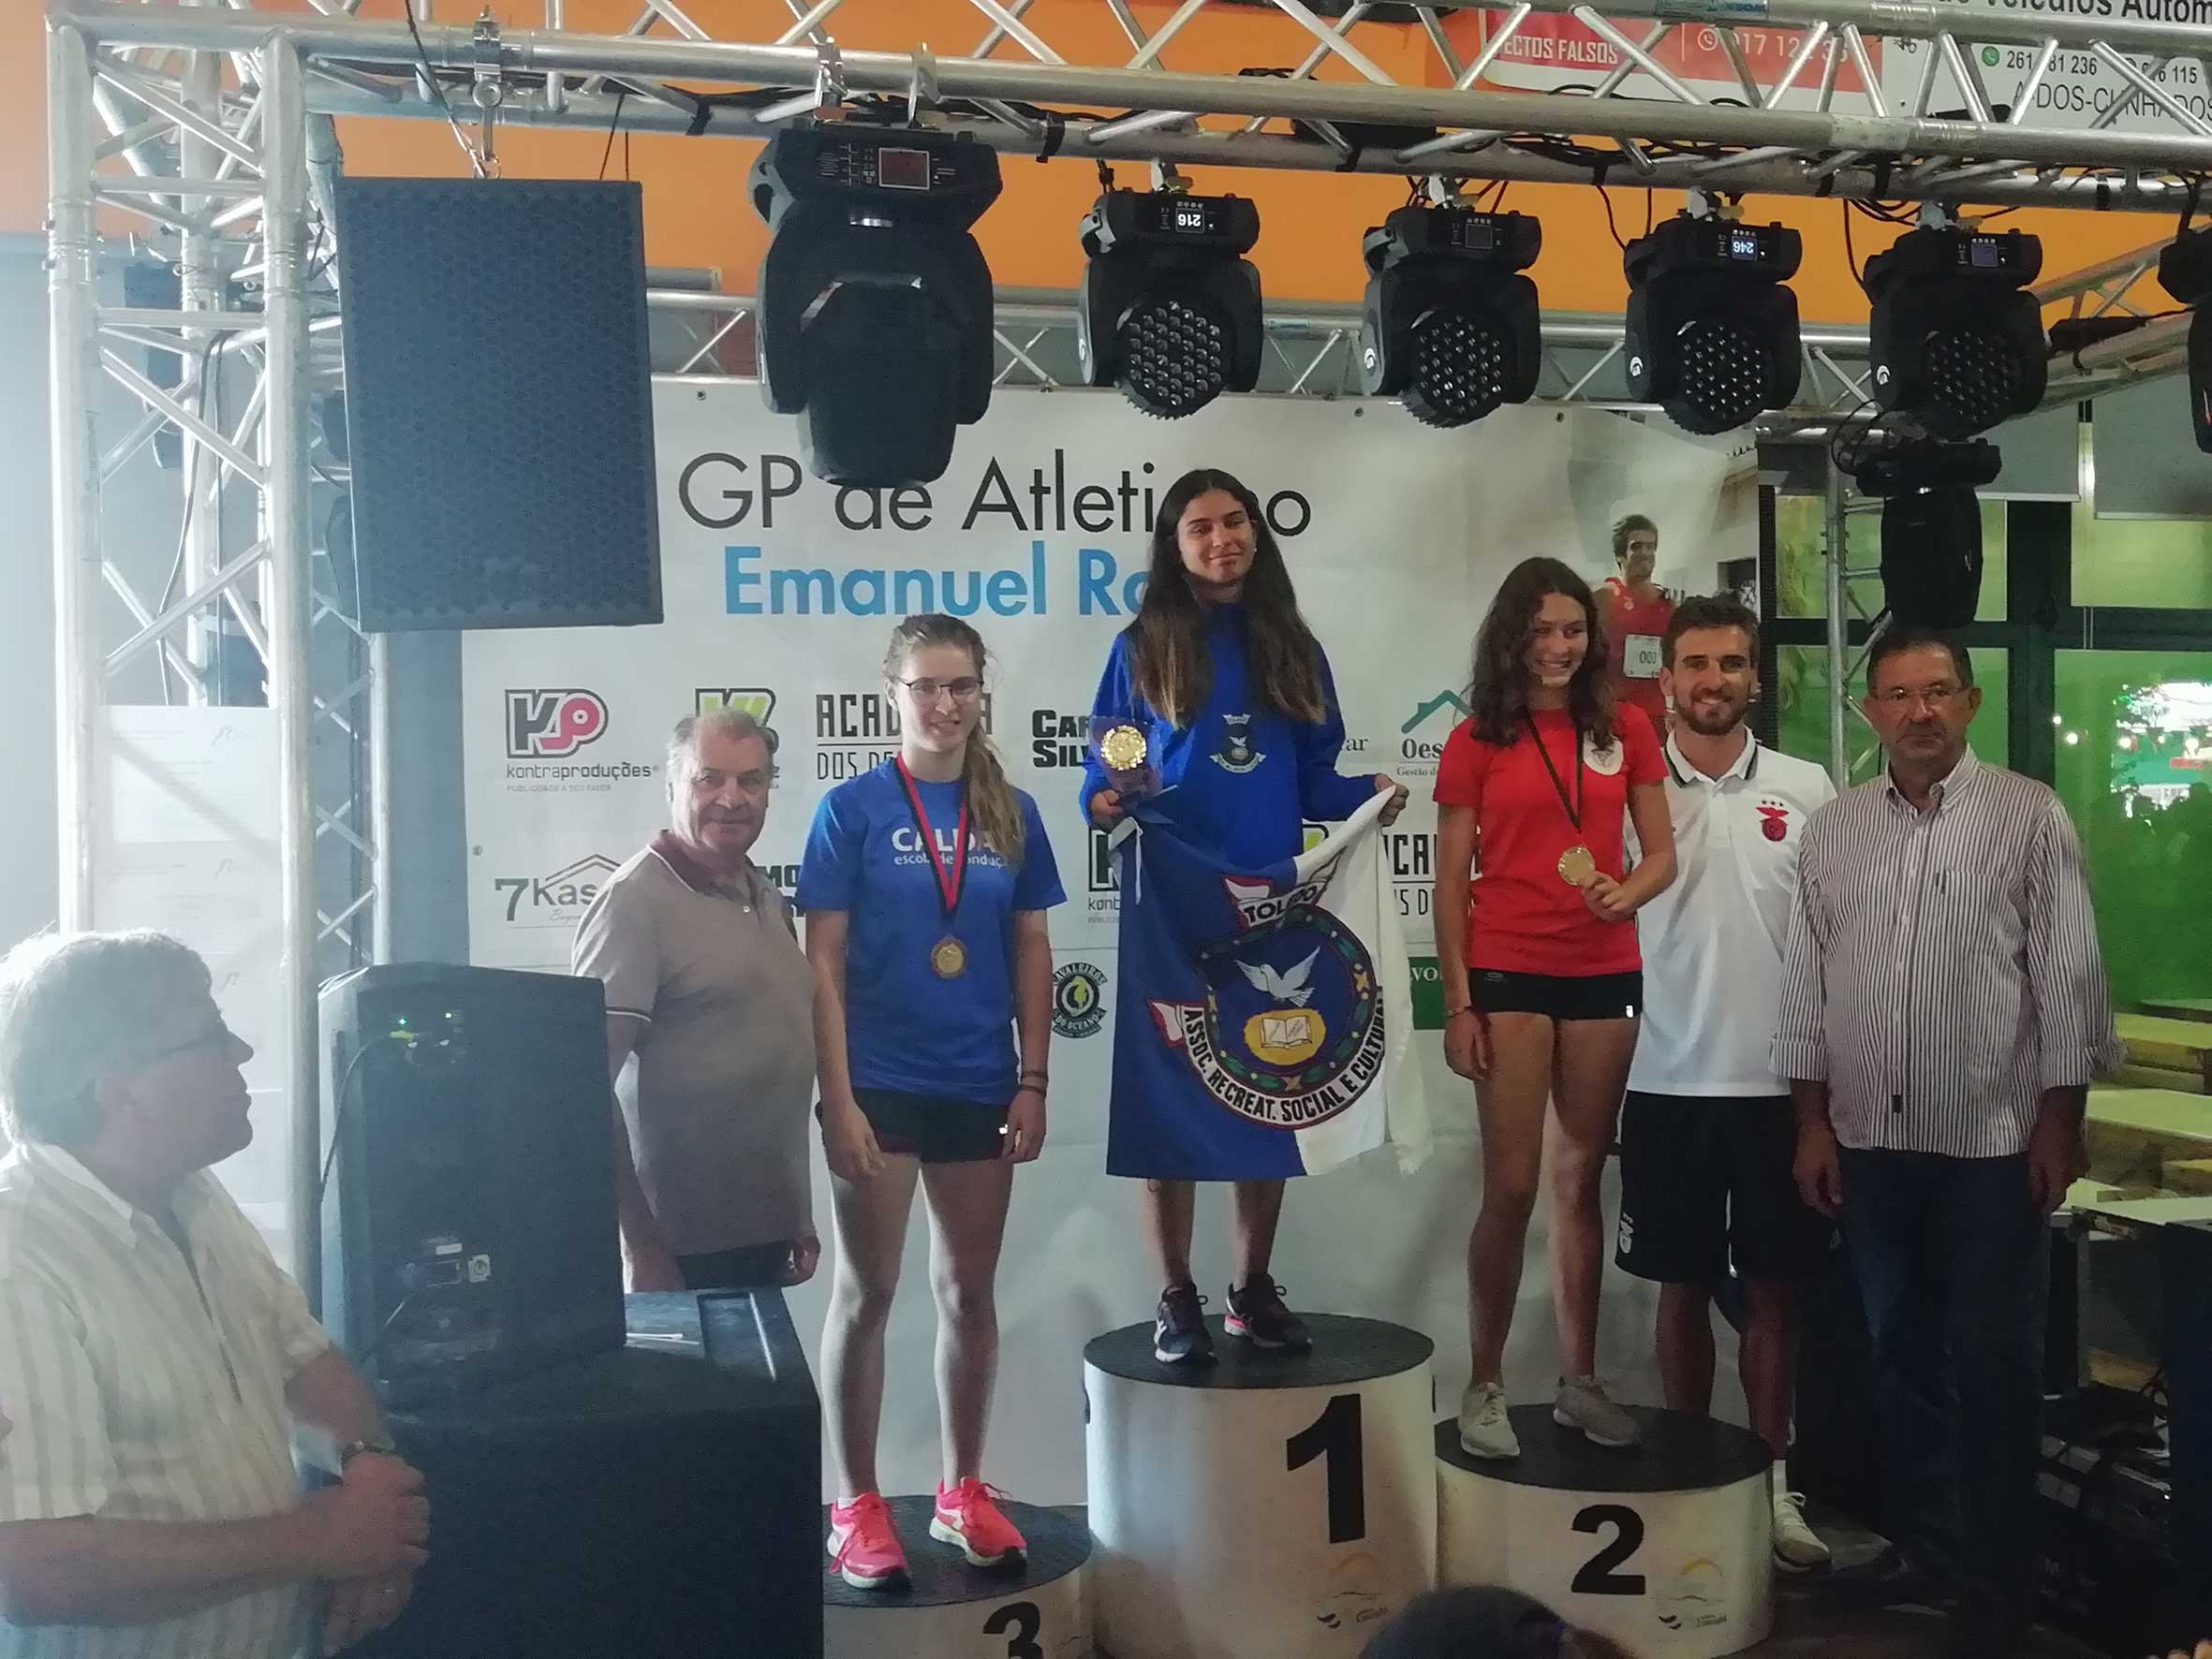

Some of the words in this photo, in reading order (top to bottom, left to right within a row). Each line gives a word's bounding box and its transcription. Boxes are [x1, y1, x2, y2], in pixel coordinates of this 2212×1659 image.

[1498, 35, 1554, 59] ECTOS
[1557, 38, 1618, 65] FALSOS
[2071, 55, 2098, 75] 236
[2173, 66, 2198, 84] 115
[1177, 213, 1202, 227] 216
[678, 452, 803, 529] GP
[962, 448, 1311, 536] Atletio
[725, 541, 1046, 616] Emanuel
[507, 761, 652, 781] kontraproduções
[1184, 1009, 1213, 1073] ASSOC.
[1208, 1070, 1277, 1121] RECREAT.
[1281, 1086, 1345, 1122] SOCIAL
[1340, 1076, 1358, 1094] E
[1286, 1393, 1365, 1544] 1
[1570, 1505, 1646, 1594] 2
[982, 1602, 1044, 1659] 3
